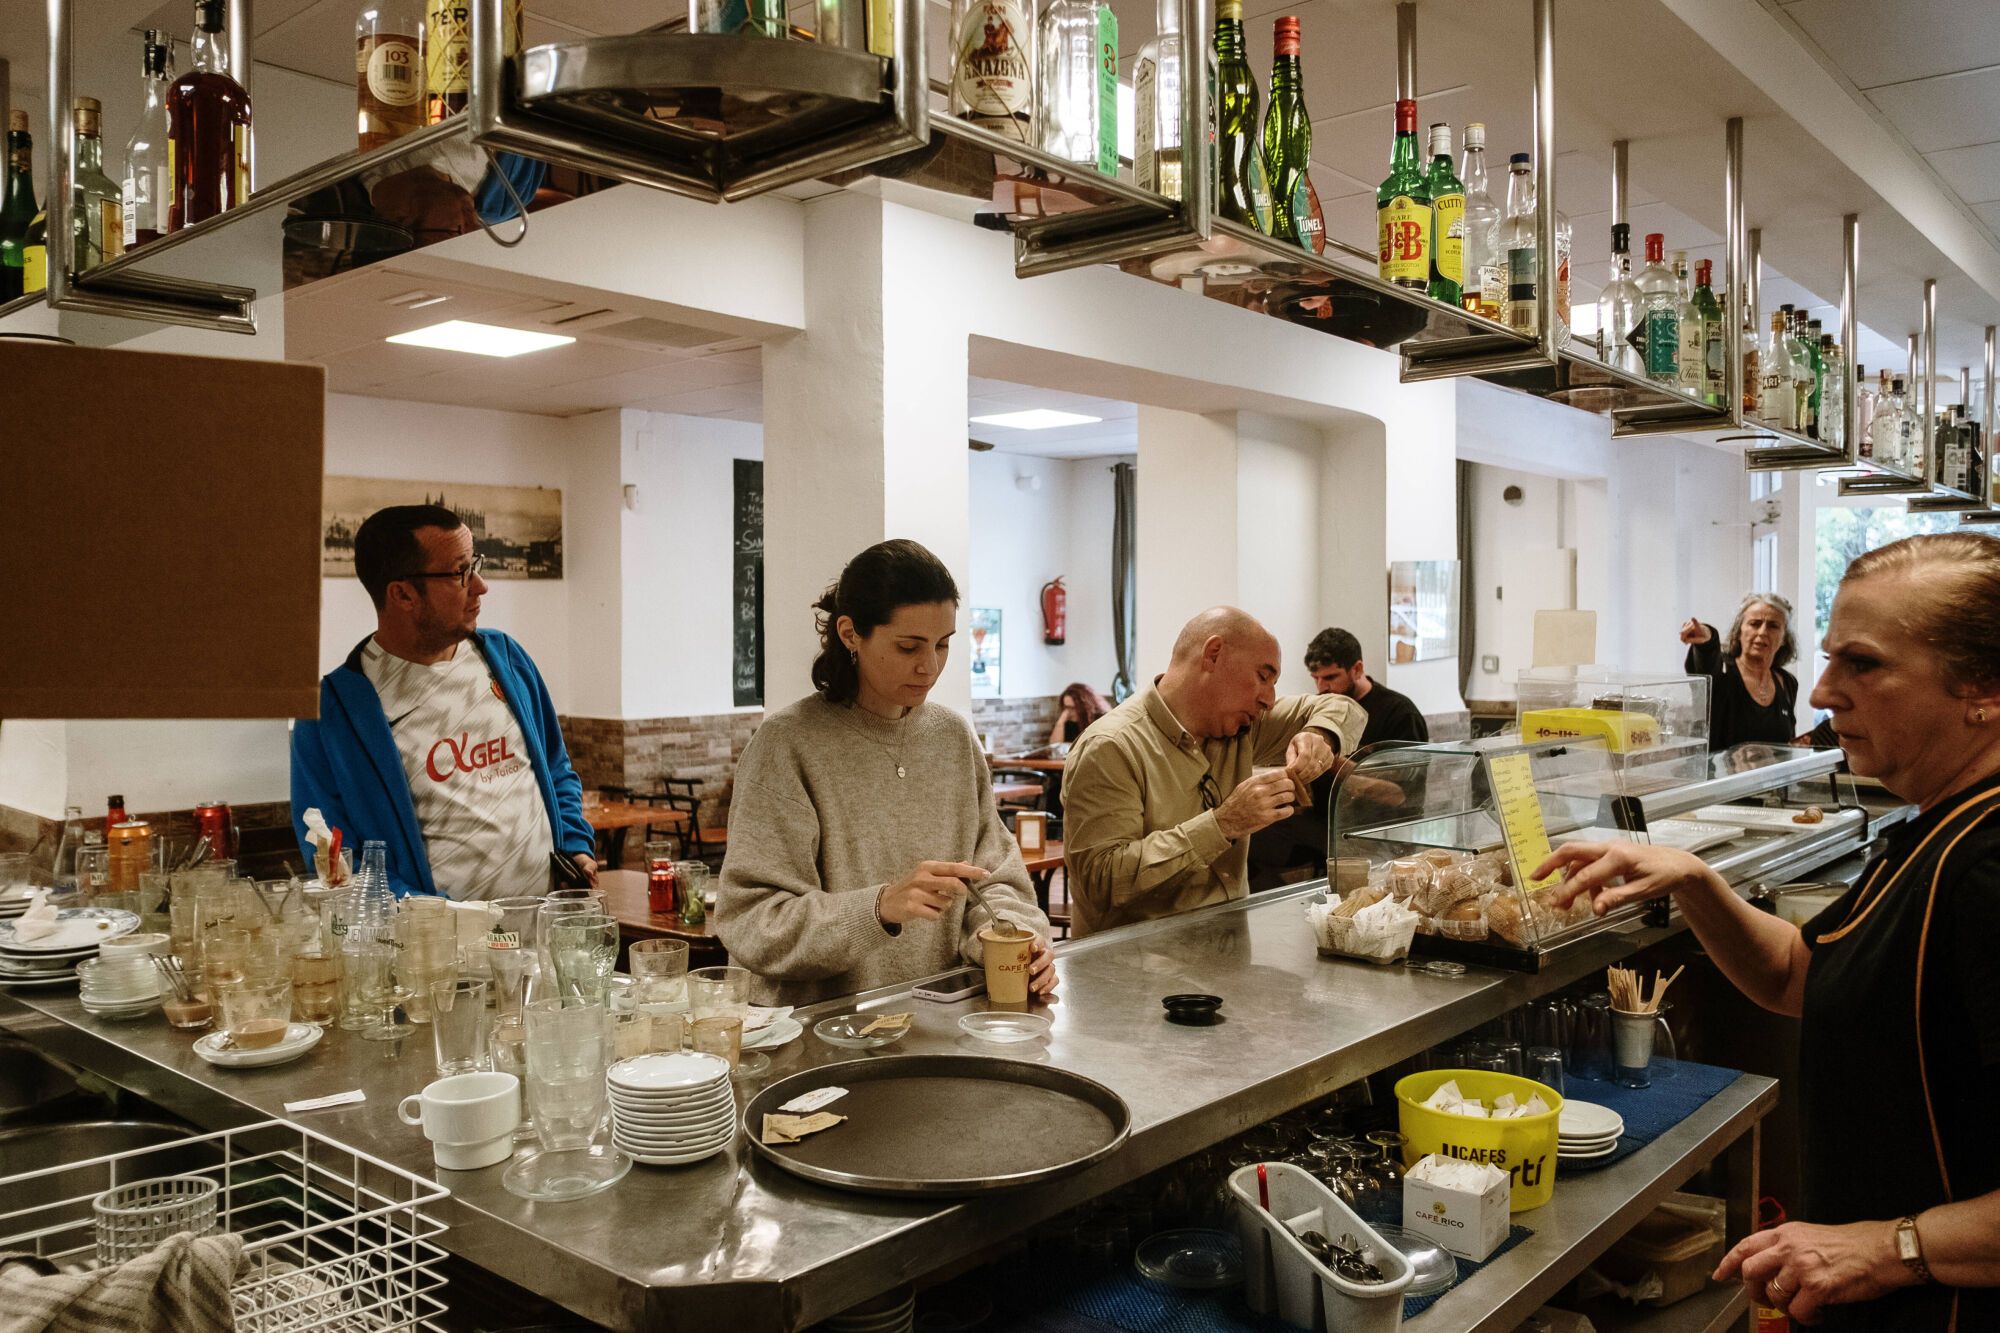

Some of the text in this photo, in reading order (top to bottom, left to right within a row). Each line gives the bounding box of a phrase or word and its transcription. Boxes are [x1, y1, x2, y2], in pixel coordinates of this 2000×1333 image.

[385, 50, 409, 65] 103
[965, 59, 1025, 81] AMAZONA
[1297, 216, 1323, 232] TÚNEL
[1381, 221, 1422, 263] J&B
[481, 773, 492, 784] by
[1459, 1146, 1506, 1164] CAFES
[1415, 1210, 1465, 1229] CAFÉ RICO
